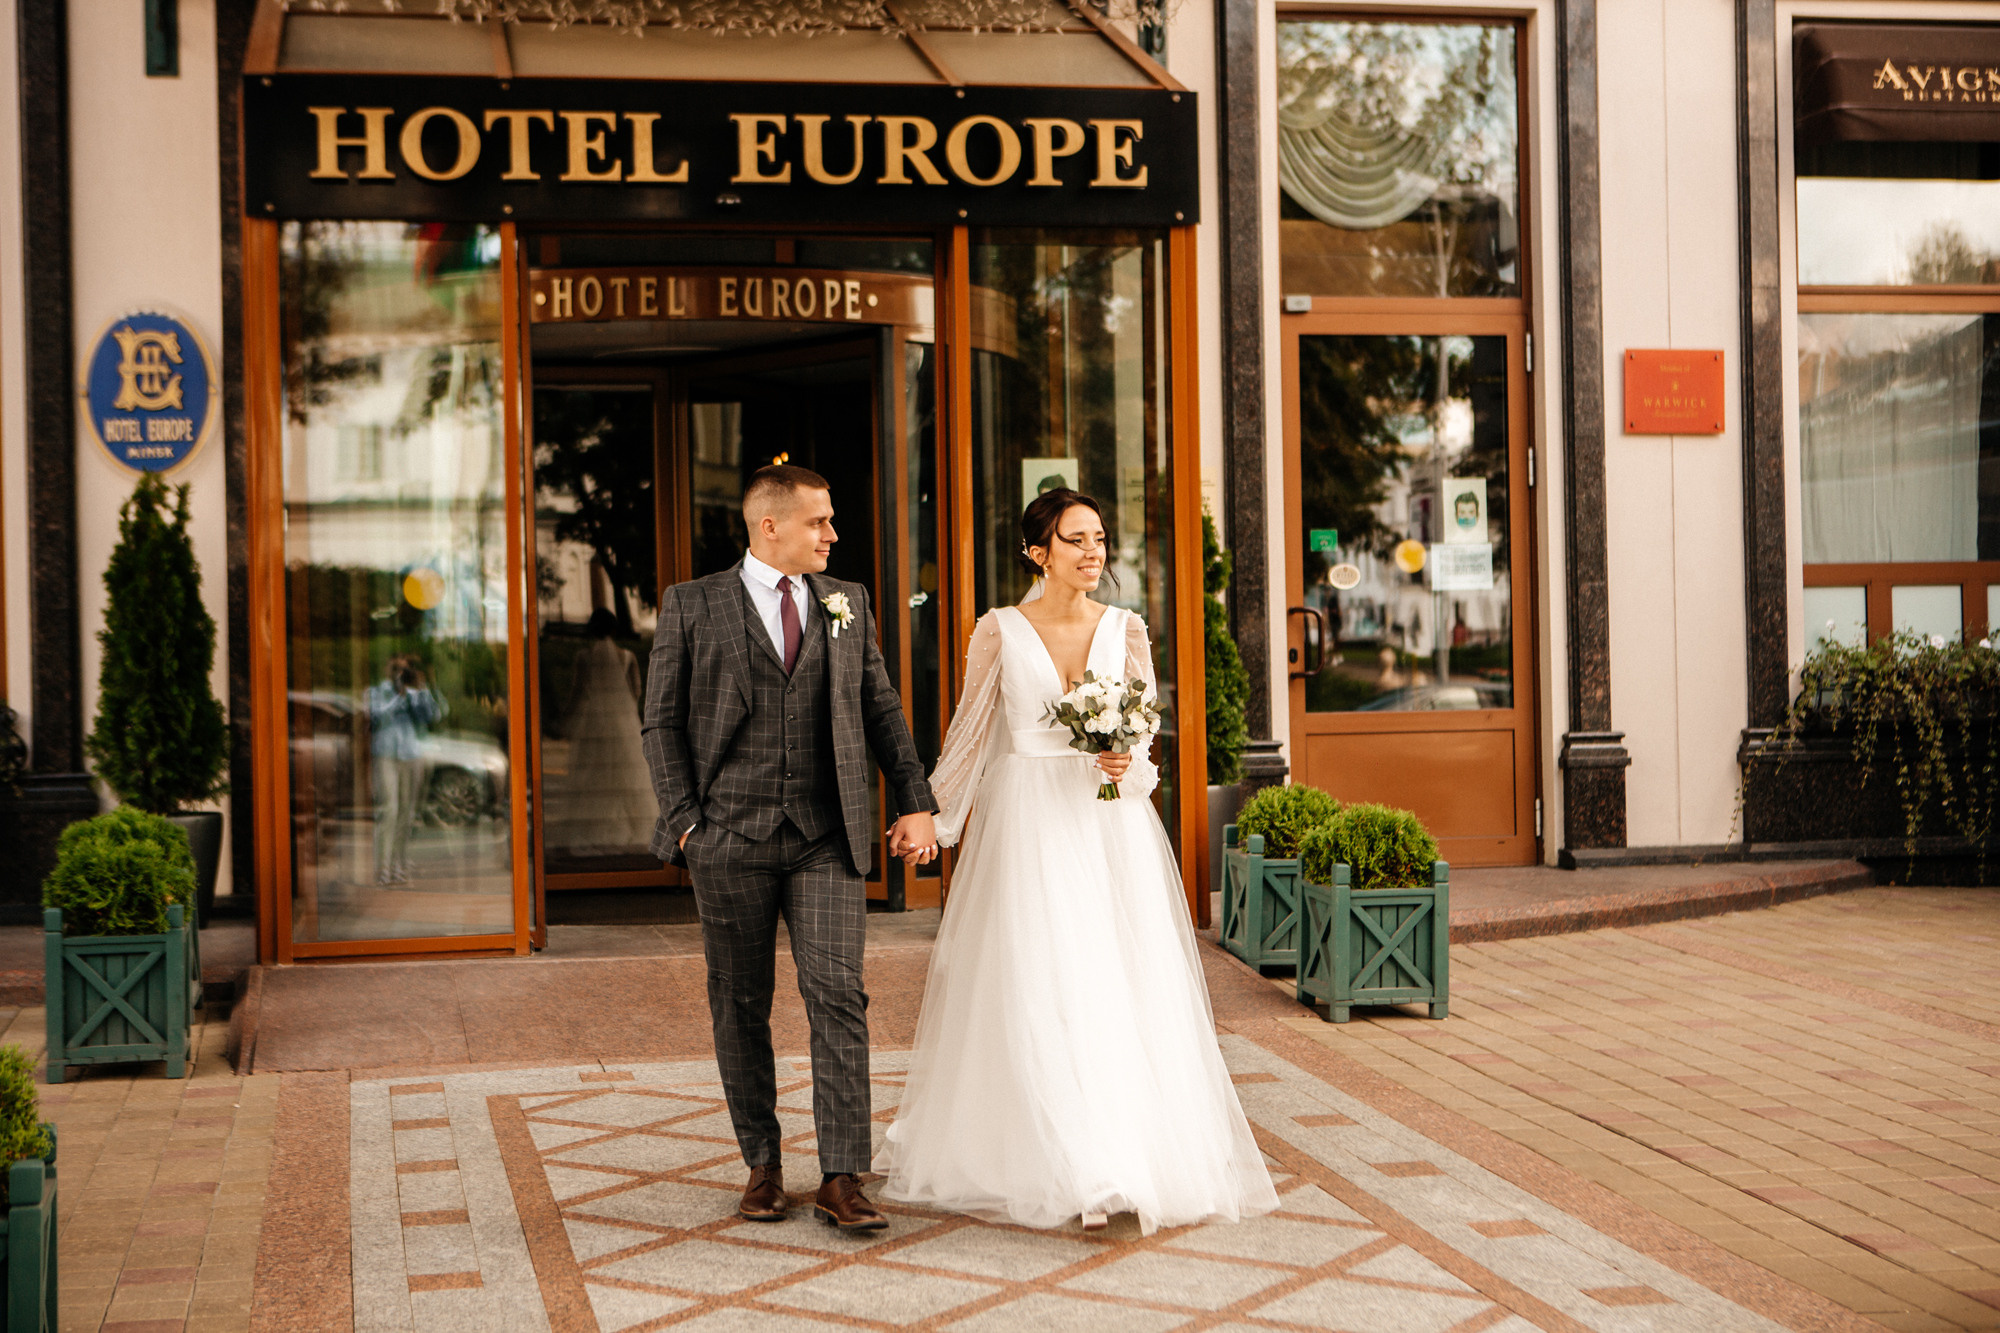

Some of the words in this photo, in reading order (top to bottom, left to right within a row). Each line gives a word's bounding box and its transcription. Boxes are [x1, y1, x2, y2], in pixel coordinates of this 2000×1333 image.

[308, 106, 689, 183] HOTEL
[728, 113, 1149, 188] EUROPE
[552, 277, 685, 318] HOTEL
[719, 277, 862, 320] EUROPE
[1643, 396, 1707, 409] WARWICK
[104, 417, 144, 442] HOTEL
[147, 417, 194, 442] EUROPE
[126, 446, 174, 459] MINSK
